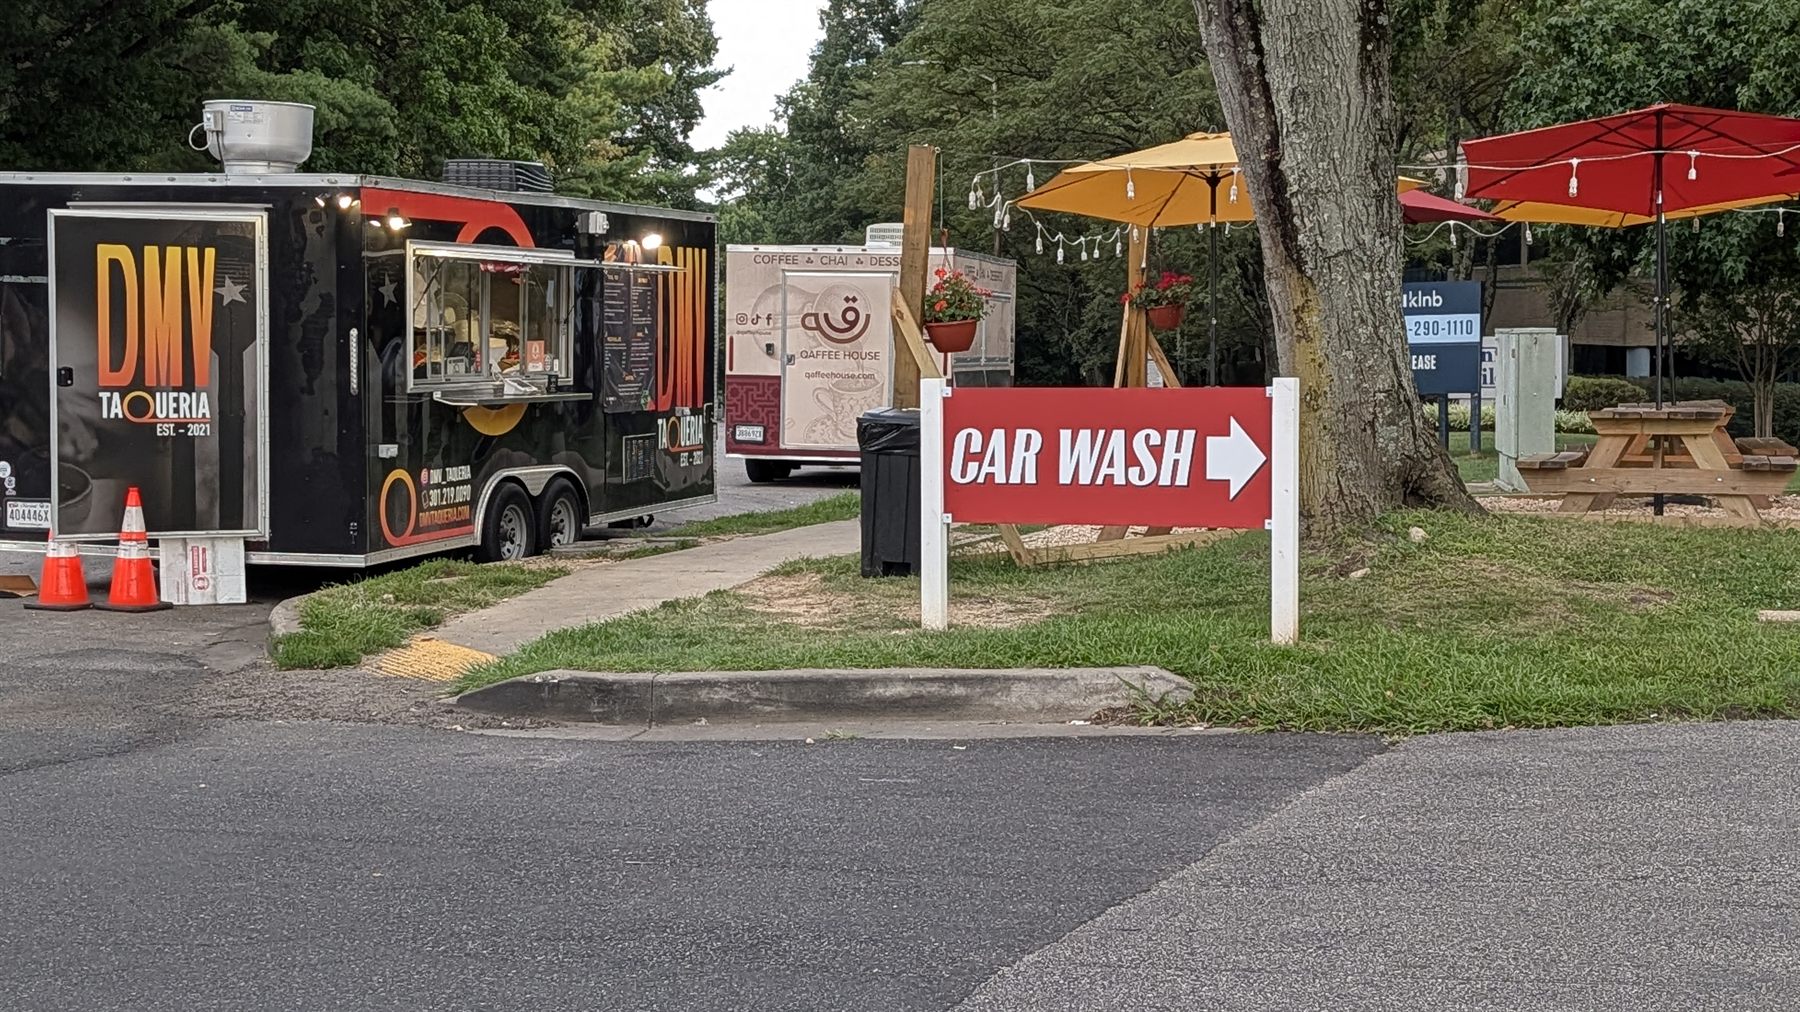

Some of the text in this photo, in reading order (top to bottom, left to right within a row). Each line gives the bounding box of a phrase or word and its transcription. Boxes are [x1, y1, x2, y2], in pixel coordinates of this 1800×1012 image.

[753, 254, 902, 267] COFFEE CHAI DESS
[97, 243, 216, 387] DMV
[657, 245, 707, 411] DMV
[1408, 319, 1473, 336] -290-1110
[800, 350, 881, 361] QAFFEE HOUSE
[1411, 354, 1437, 370] EASE
[804, 370, 876, 380] qaffeehouse.com
[98, 390, 211, 423] TAQUERIA
[156, 423, 176, 436] EST.
[187, 423, 211, 436] 2021
[657, 415, 704, 453] TAQUERIA
[950, 427, 1197, 488] CAR WASH
[9, 508, 49, 522] 404446X
